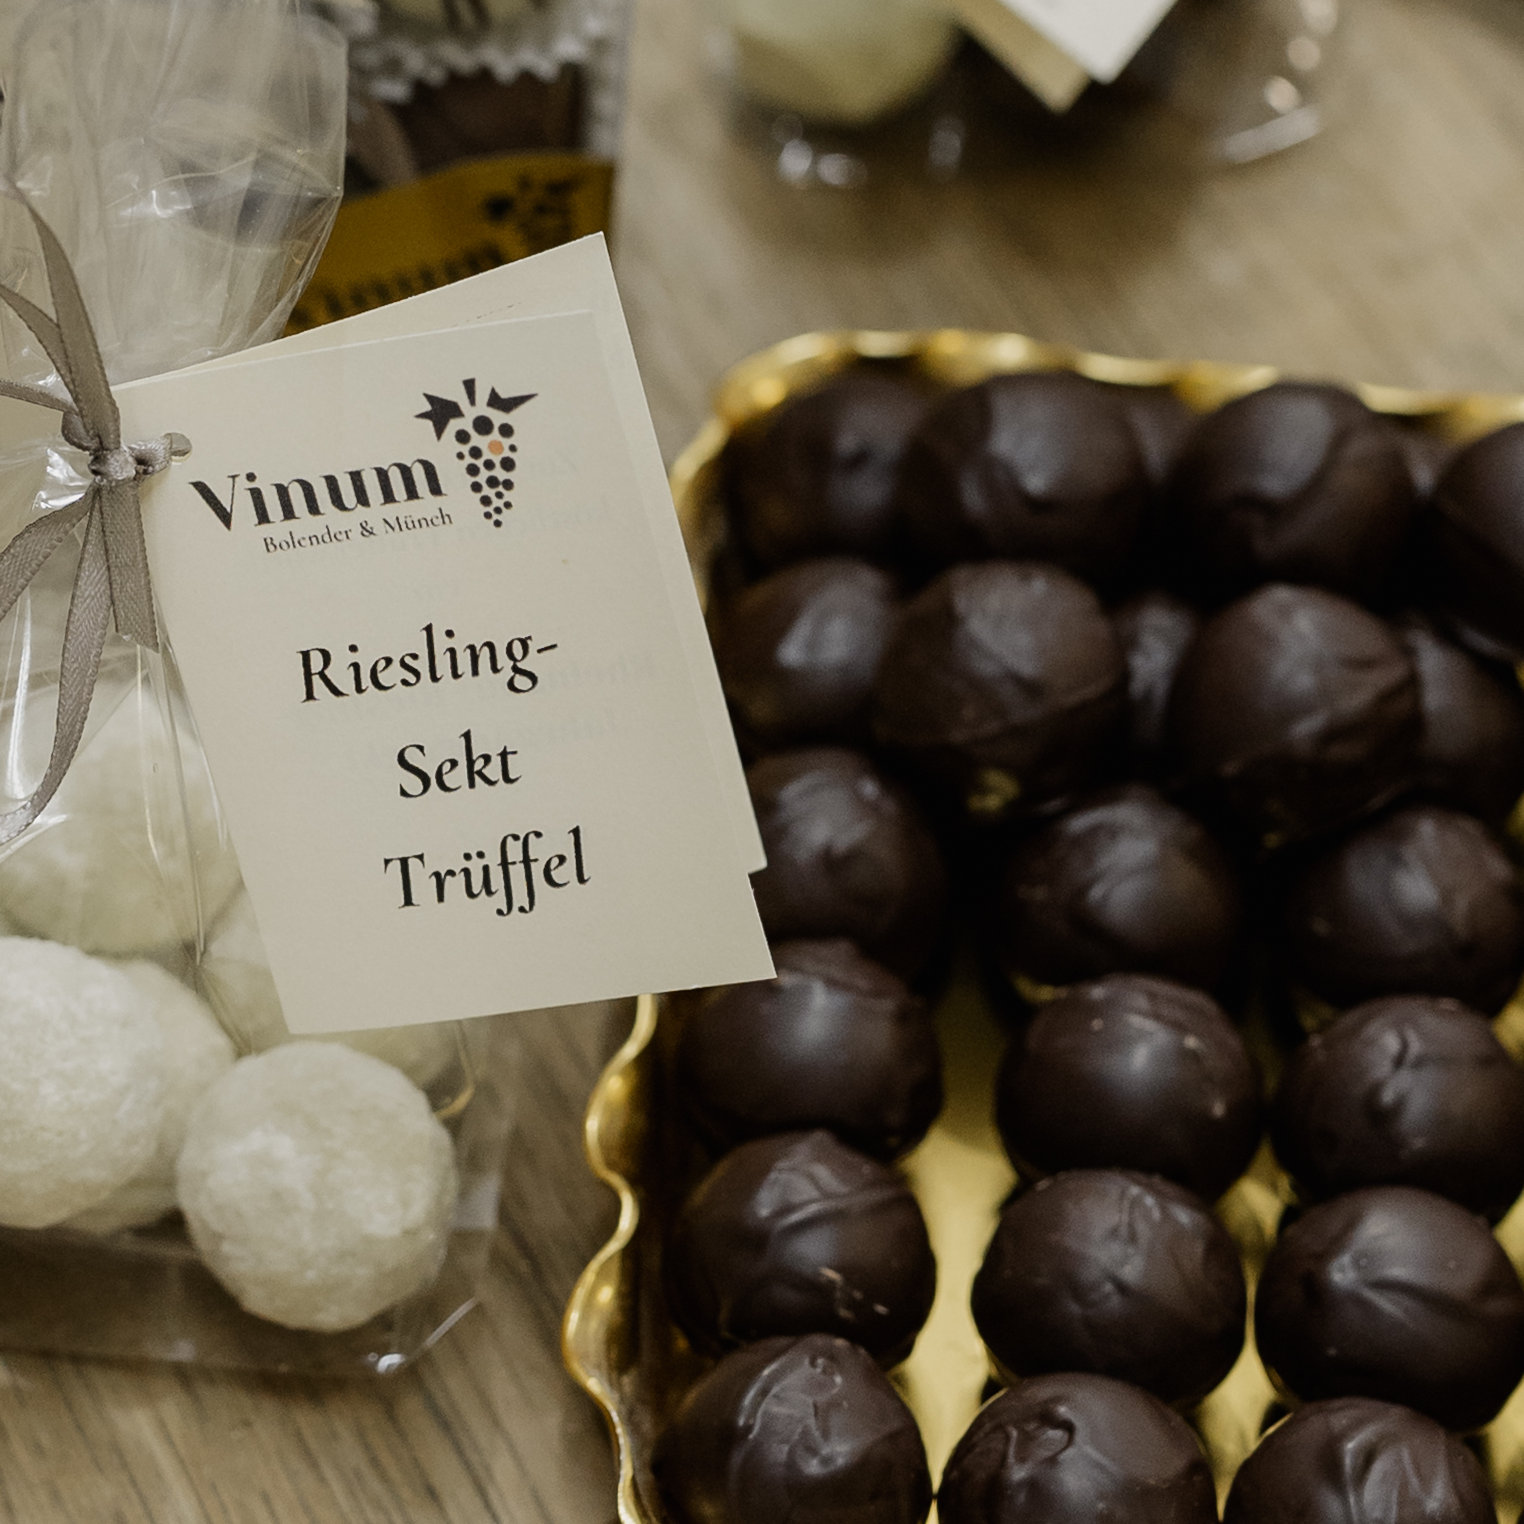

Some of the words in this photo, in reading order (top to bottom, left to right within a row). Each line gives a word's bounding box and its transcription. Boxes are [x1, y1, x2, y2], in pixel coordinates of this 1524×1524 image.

[188, 456, 448, 532] Vinum
[262, 524, 354, 554] Bolender
[359, 519, 378, 539] &
[381, 506, 454, 535] Münch
[296, 622, 559, 705] Riesling-
[395, 730, 524, 799] Sekt
[383, 825, 592, 918] Trüffel
